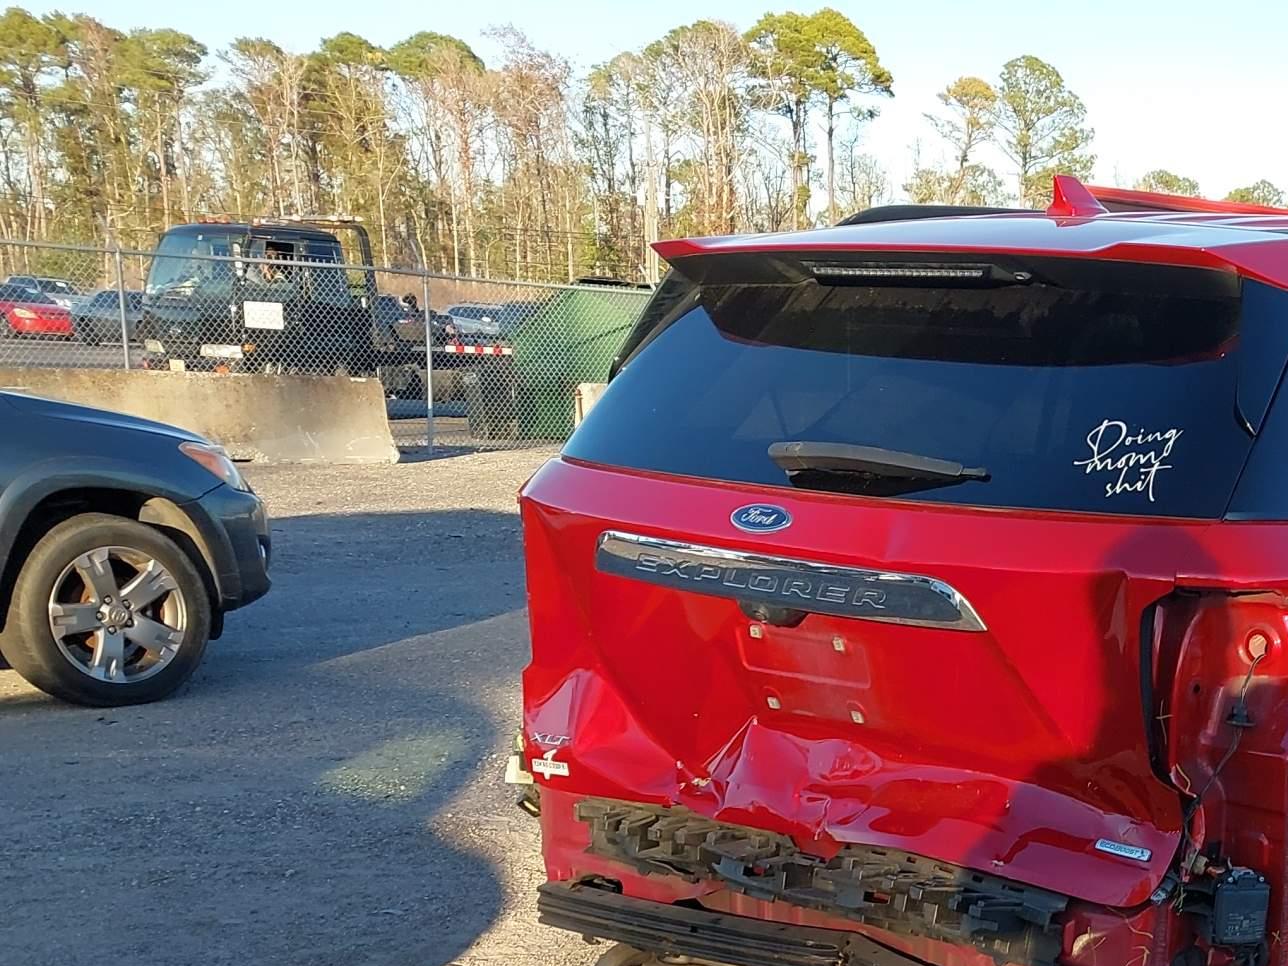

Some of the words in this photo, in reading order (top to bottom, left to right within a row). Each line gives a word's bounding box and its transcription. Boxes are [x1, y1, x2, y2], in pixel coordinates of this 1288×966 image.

[1074, 419, 1184, 465] Doing
[1085, 451, 1162, 474] mom
[1104, 461, 1173, 502] shit
[741, 507, 778, 525] Ford
[636, 552, 887, 609] EXPLORER
[530, 732, 571, 745] XLT
